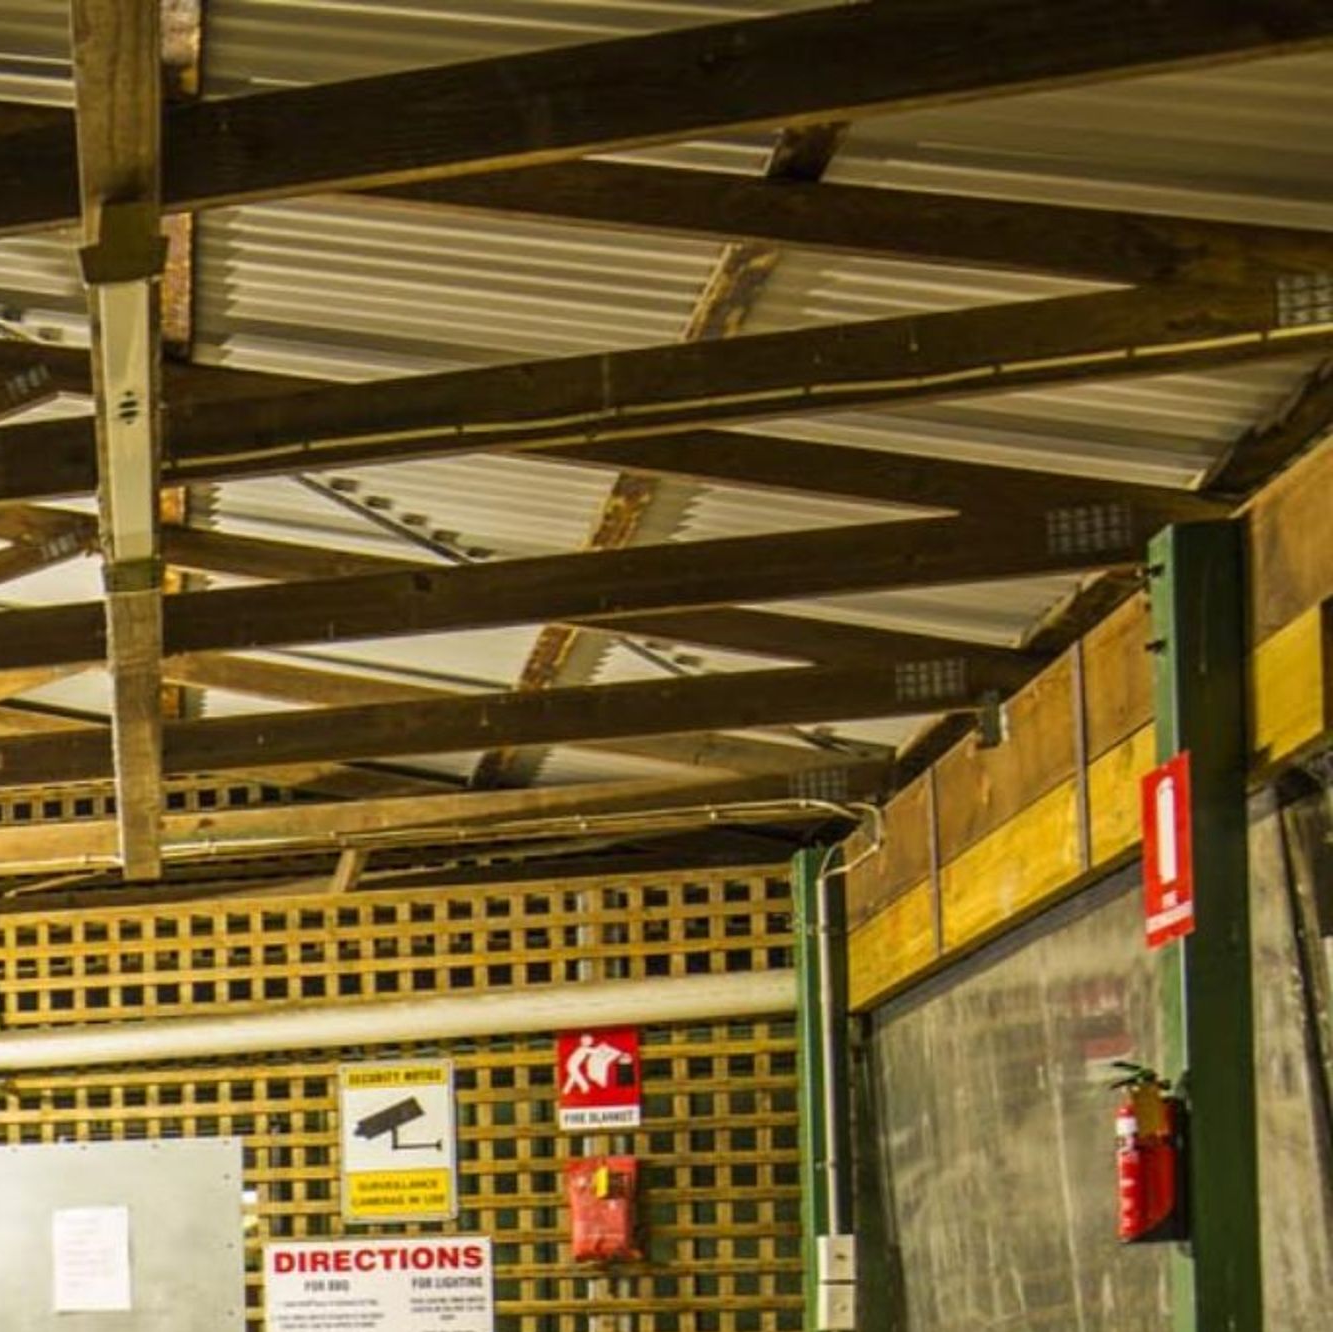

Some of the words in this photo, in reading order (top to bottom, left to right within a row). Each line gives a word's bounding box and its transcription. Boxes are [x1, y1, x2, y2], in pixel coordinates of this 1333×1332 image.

[274, 1246, 483, 1273] DIRECTIONS
[304, 1280, 325, 1291] FOR
[412, 1277, 432, 1289] FOR
[435, 1276, 483, 1288] LIGHTING
